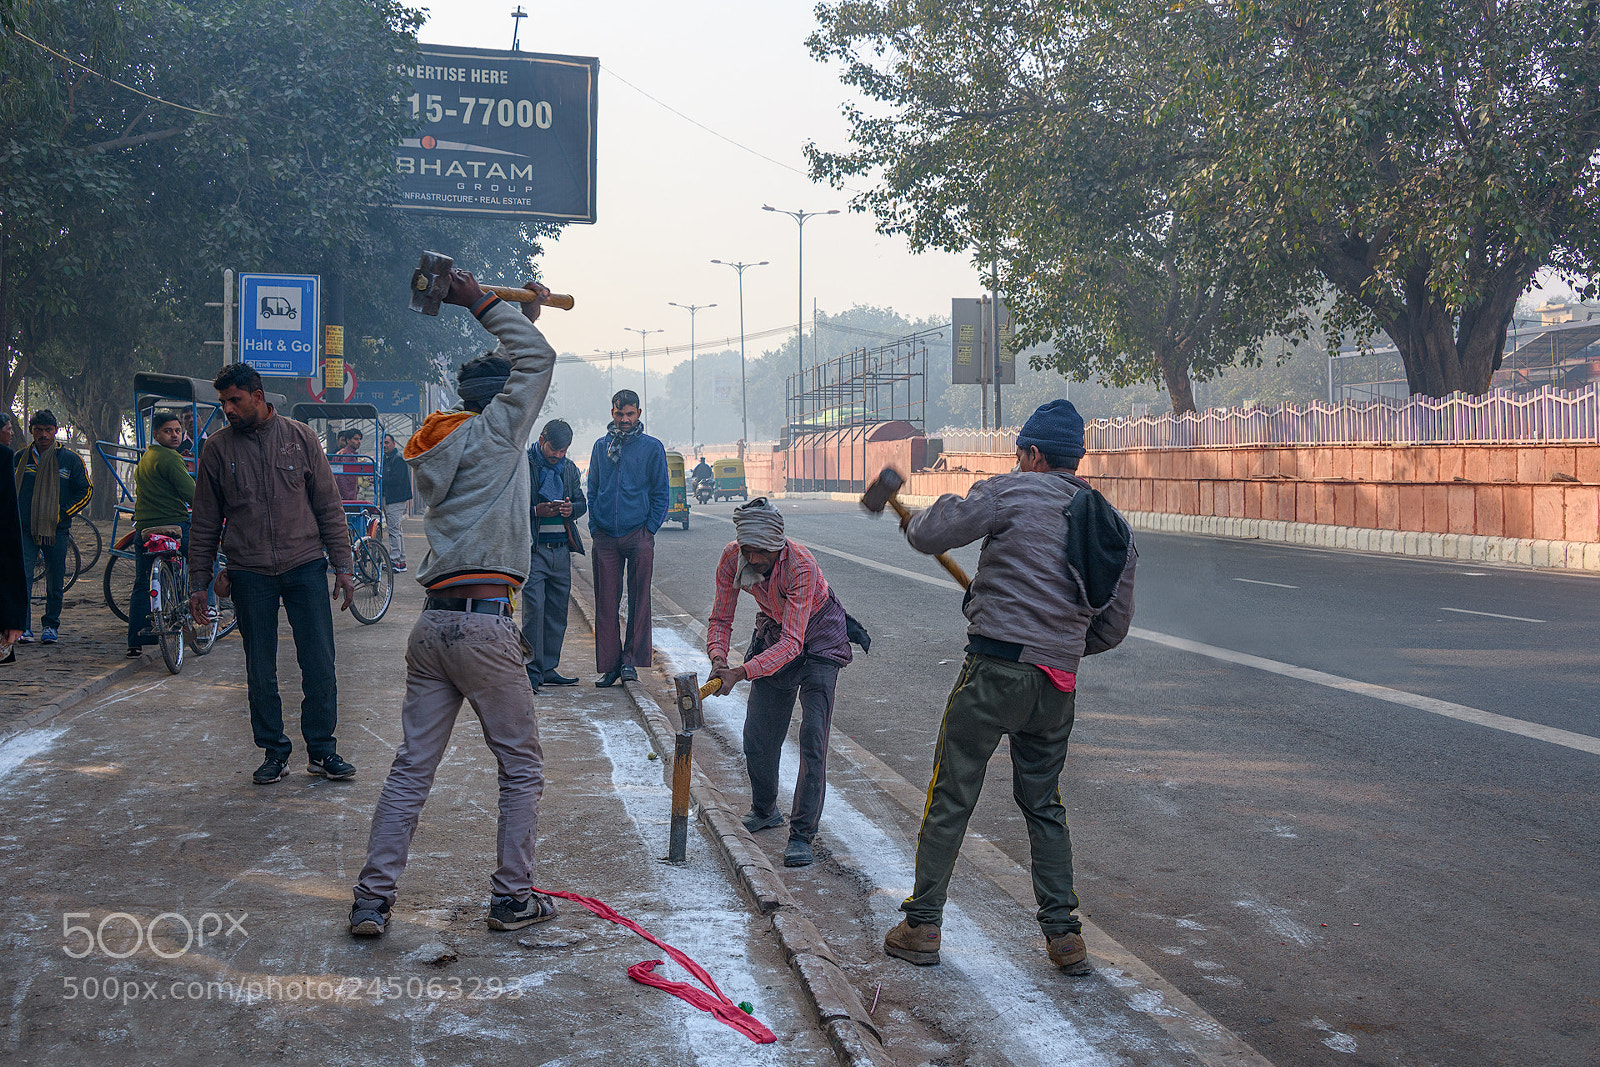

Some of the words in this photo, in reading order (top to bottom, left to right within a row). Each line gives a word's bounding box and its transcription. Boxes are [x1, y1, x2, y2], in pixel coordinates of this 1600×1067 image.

[471, 69, 509, 84] HERE
[391, 91, 553, 130] 15-77000
[456, 182, 533, 193] GROUP
[480, 196, 501, 205] REAL
[502, 197, 532, 206] ESTATE
[245, 338, 273, 351] Halt
[276, 339, 288, 352] &
[291, 340, 312, 352] Go
